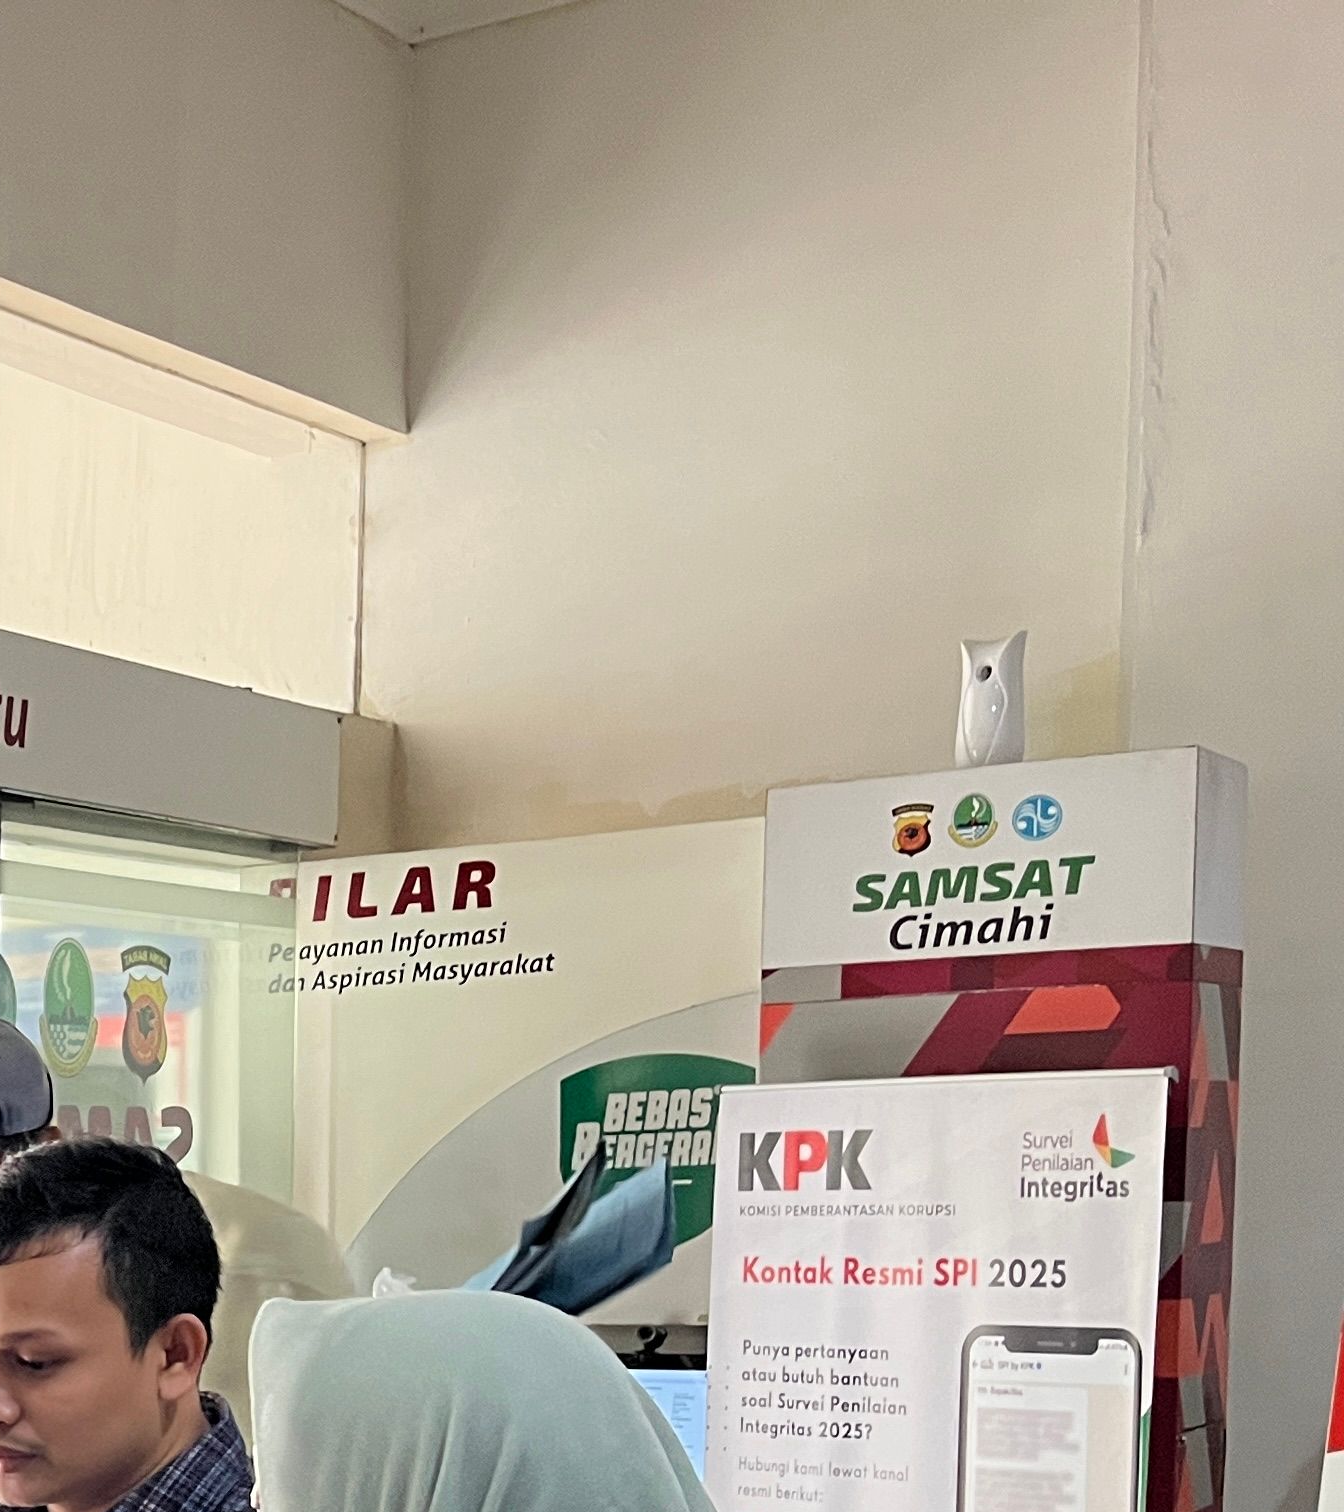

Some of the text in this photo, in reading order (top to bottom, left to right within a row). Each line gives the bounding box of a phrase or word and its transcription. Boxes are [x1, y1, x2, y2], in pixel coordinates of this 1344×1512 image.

[853, 855, 1096, 912] SAMSAT
[889, 903, 1054, 950] Cimahi
[268, 921, 508, 966] Peayanan Informasi
[312, 963, 405, 994] Aspirasi
[412, 953, 555, 985] Masyarakat
[603, 1087, 713, 1132] BEBAS
[571, 1121, 716, 1175] BERGERA
[1022, 1129, 1073, 1149] Survei
[738, 1129, 873, 1191] KPK
[1021, 1153, 1094, 1172] Penilaian
[1020, 1171, 1130, 1202] Integritas
[739, 1204, 956, 1217] KOMISI PEMBERANTASAN KORUPSI
[742, 1255, 1067, 1288] Kontak Resmi SPI 2025
[743, 1339, 889, 1364] Punya pertanyaan
[741, 1366, 899, 1388] atau butuh bantuan
[741, 1392, 907, 1416] soal Survei Penilaian
[740, 1417, 873, 1440] Integritas 2025?
[738, 1456, 909, 1482] Hubungi kami lewat kanal
[737, 1485, 772, 1498] resmi
